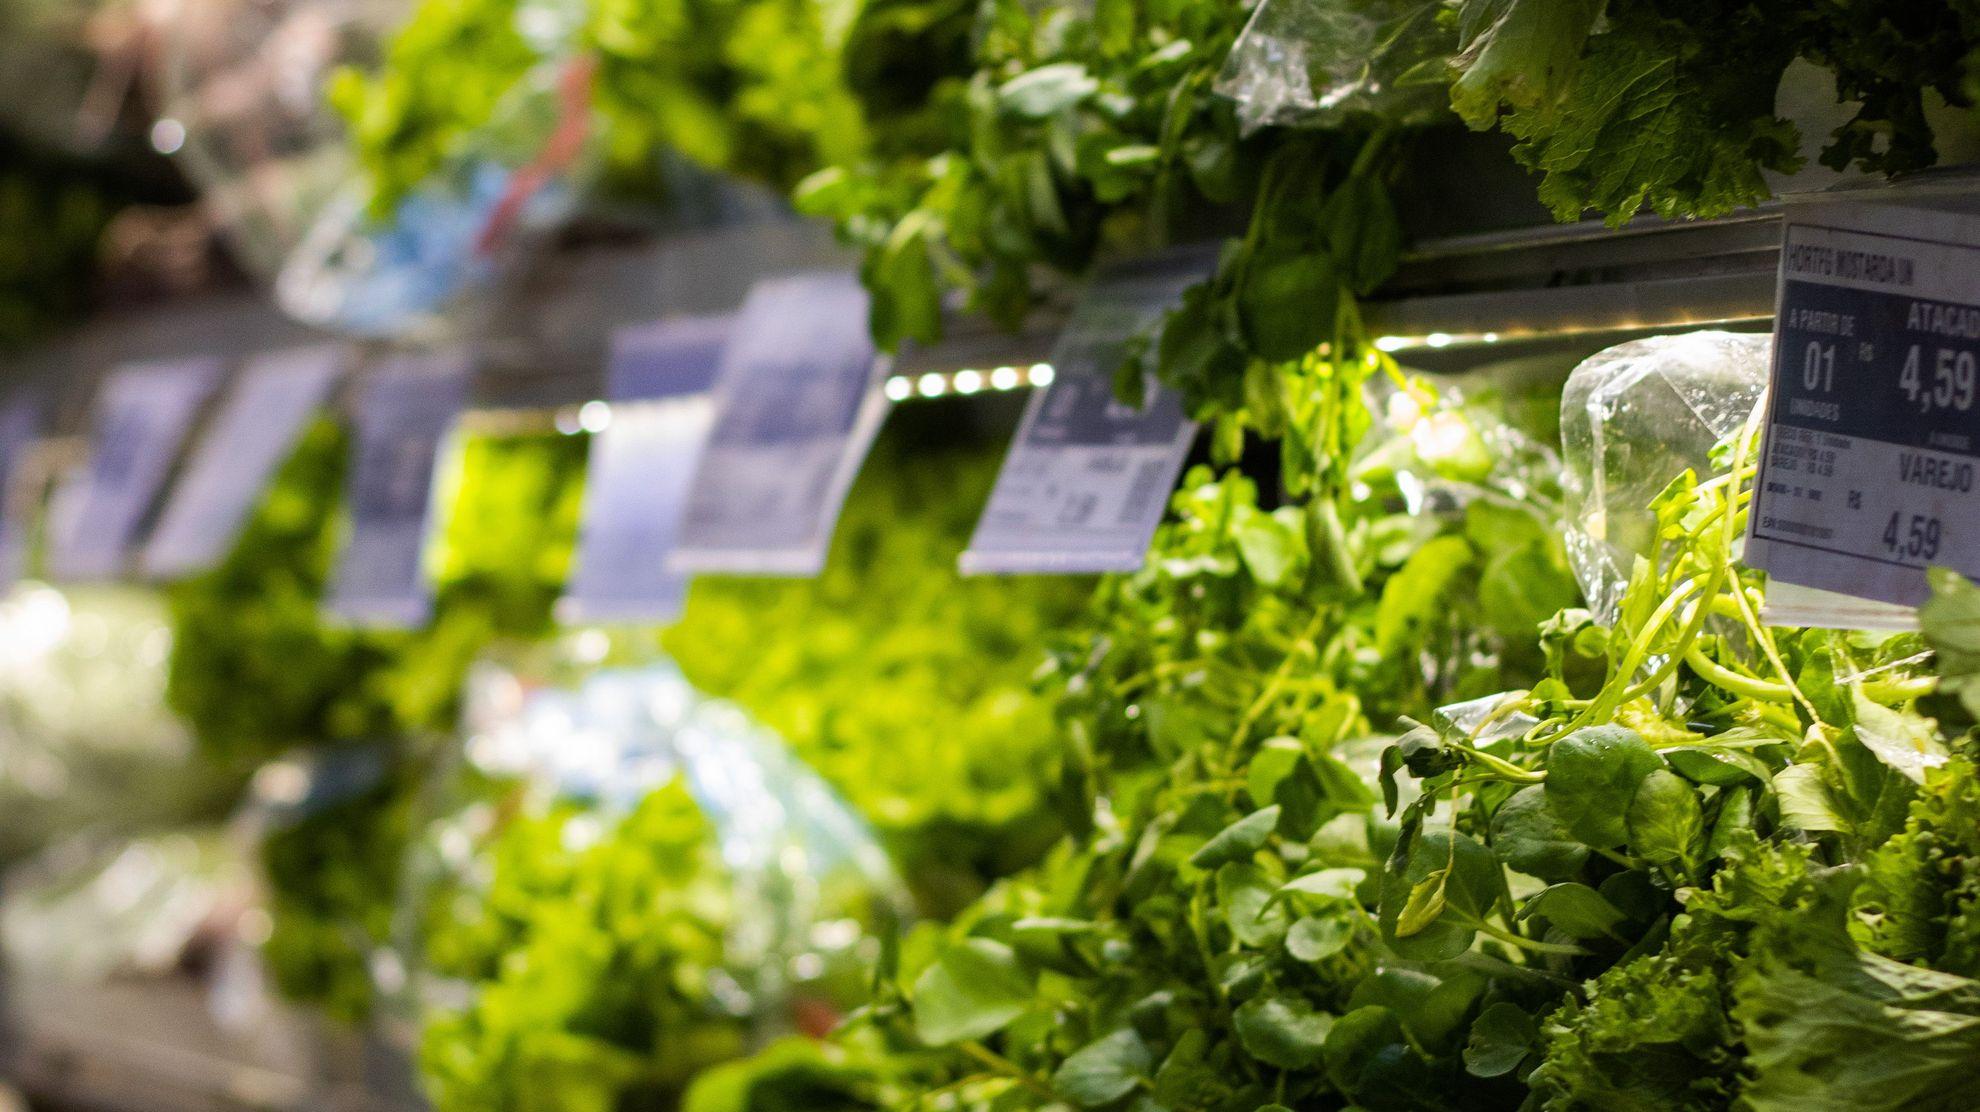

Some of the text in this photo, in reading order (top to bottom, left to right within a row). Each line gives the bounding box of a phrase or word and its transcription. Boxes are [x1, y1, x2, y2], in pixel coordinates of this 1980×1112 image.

[1788, 308, 1797, 328] A
[1804, 341, 1836, 392] 01
[1899, 345, 1975, 413] 4,59
[1900, 453, 1972, 492] VAREJO
[1882, 511, 1941, 561] 4,59
